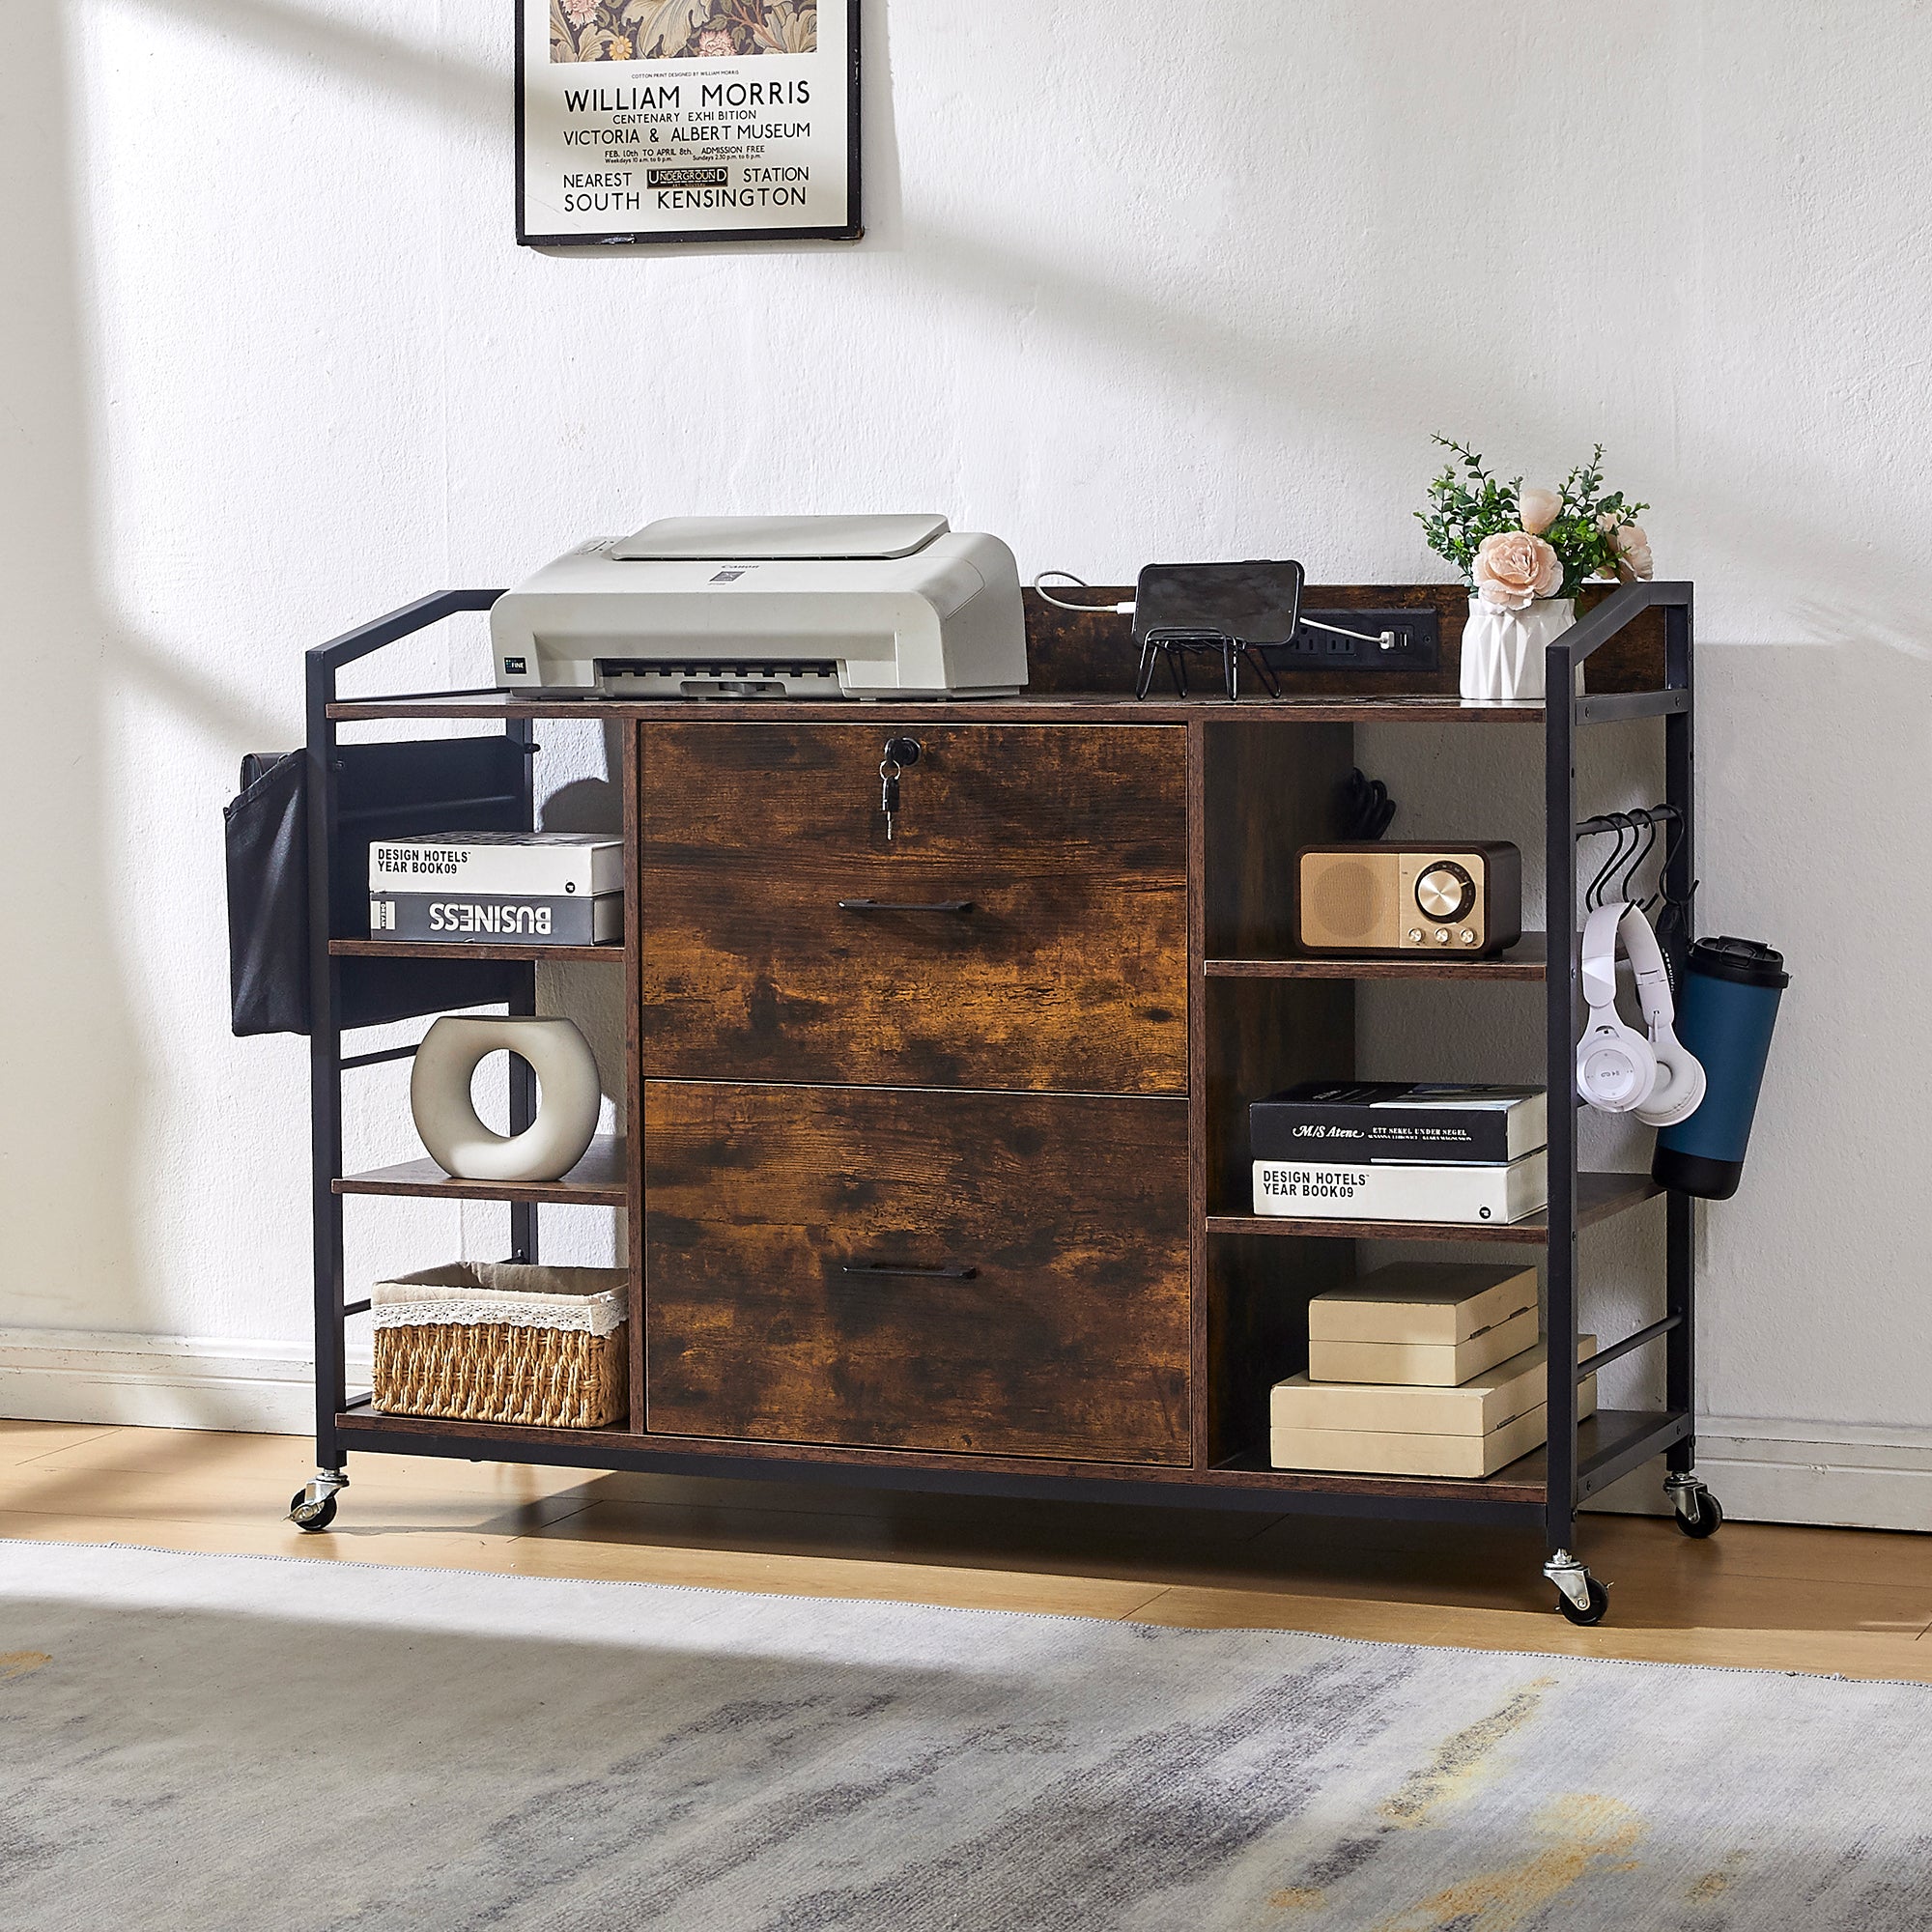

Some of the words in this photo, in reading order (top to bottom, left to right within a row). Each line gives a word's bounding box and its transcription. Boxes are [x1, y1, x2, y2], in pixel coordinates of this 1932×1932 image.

[564, 85, 679, 112] WILLIAM
[701, 80, 810, 107] MORRIS
[612, 112, 680, 125] CENTENARY
[563, 128, 640, 146] VICTORIA
[649, 128, 659, 143] &
[670, 125, 731, 142] ALBERT
[737, 123, 810, 139] MUSEUM
[605, 150, 620, 158] FEB.
[701, 146, 743, 155] ADMISSION
[563, 172, 633, 188] NEAREST
[743, 166, 810, 183] STATION
[564, 191, 639, 212] SOUTH
[658, 186, 806, 210] KENSINGTON
[378, 848, 419, 861] DESIGN
[378, 860, 408, 872] YEAR
[429, 902, 552, 935] BUSINESS
[1292, 1124, 1326, 1138] M/S
[1263, 1170, 1311, 1183] DESIGN
[1263, 1182, 1297, 1196] YEAR
